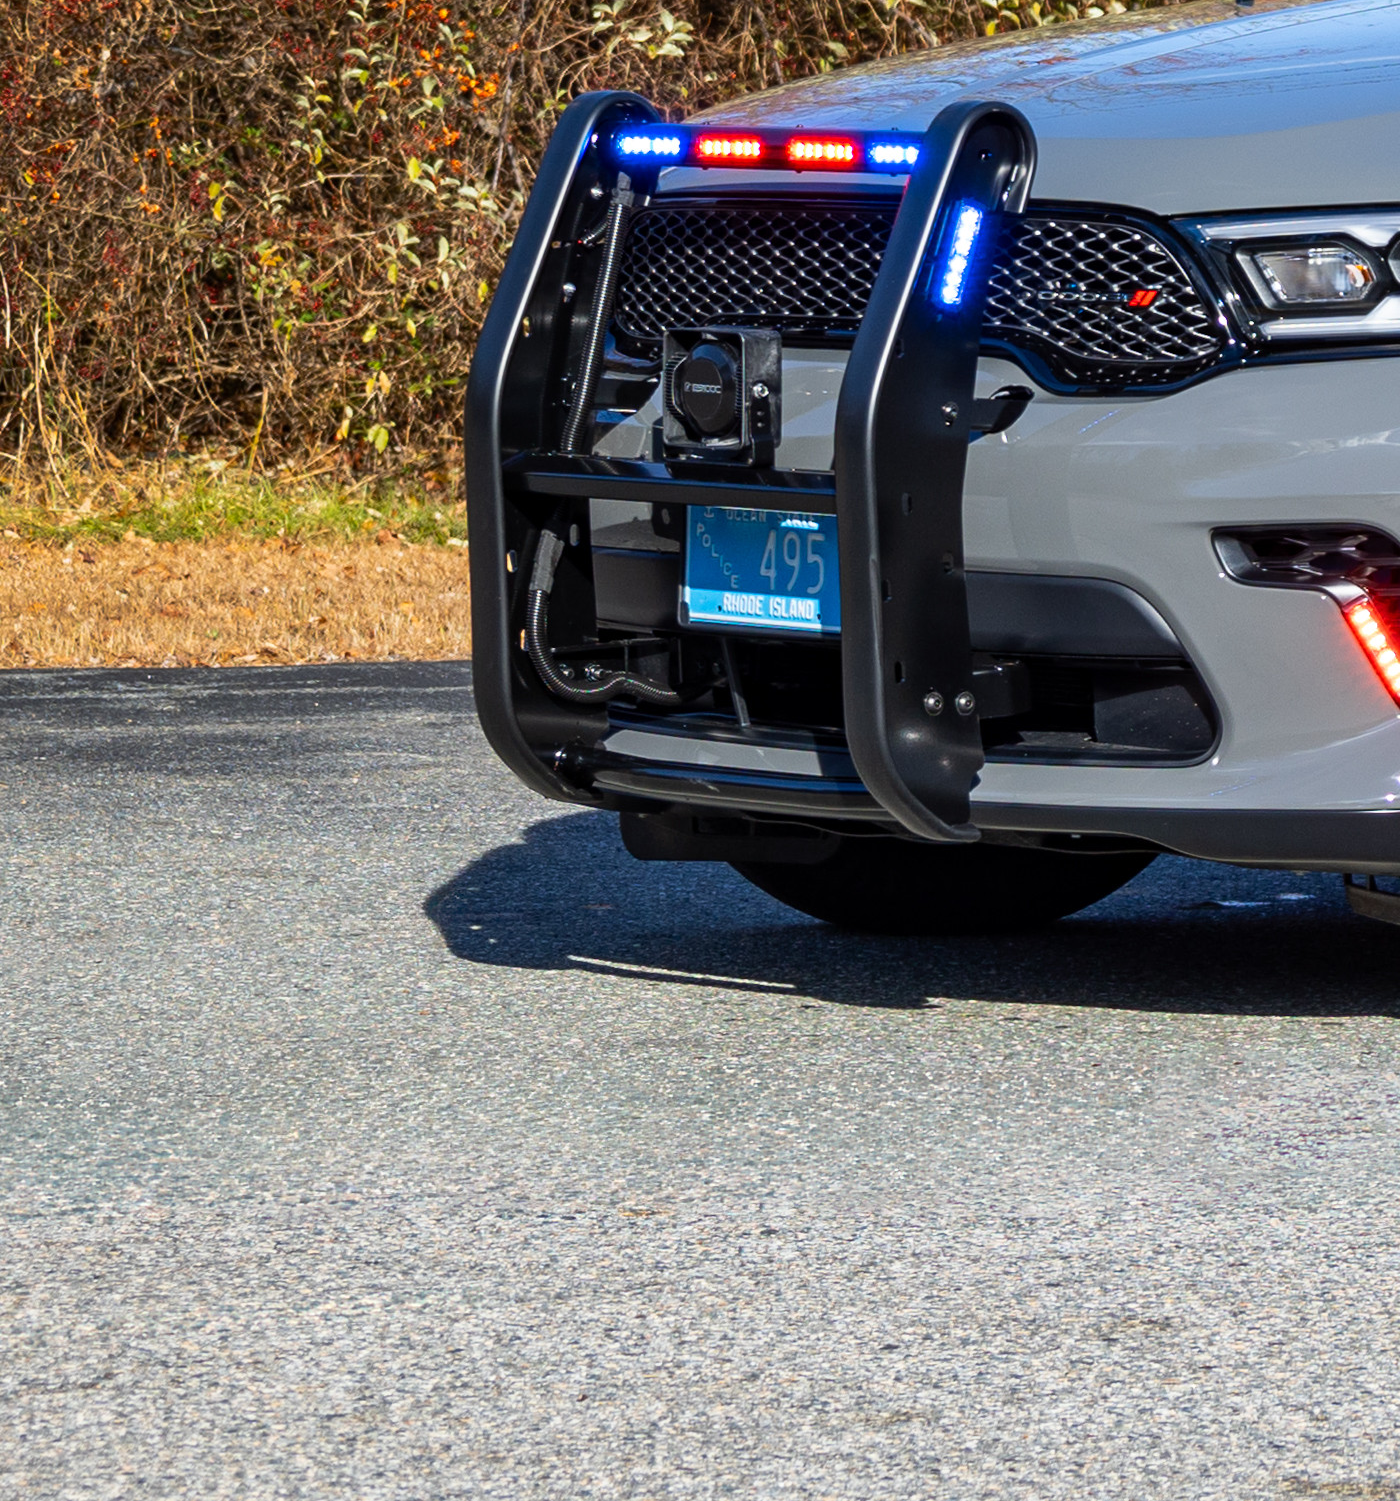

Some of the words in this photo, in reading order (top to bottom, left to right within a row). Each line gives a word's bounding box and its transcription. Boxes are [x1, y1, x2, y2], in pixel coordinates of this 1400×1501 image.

[725, 507, 767, 523] OCEAN
[696, 522, 739, 589] POLICE
[759, 528, 826, 595] 495
[722, 593, 764, 616] RHODE
[768, 597, 815, 621] ISLAND
